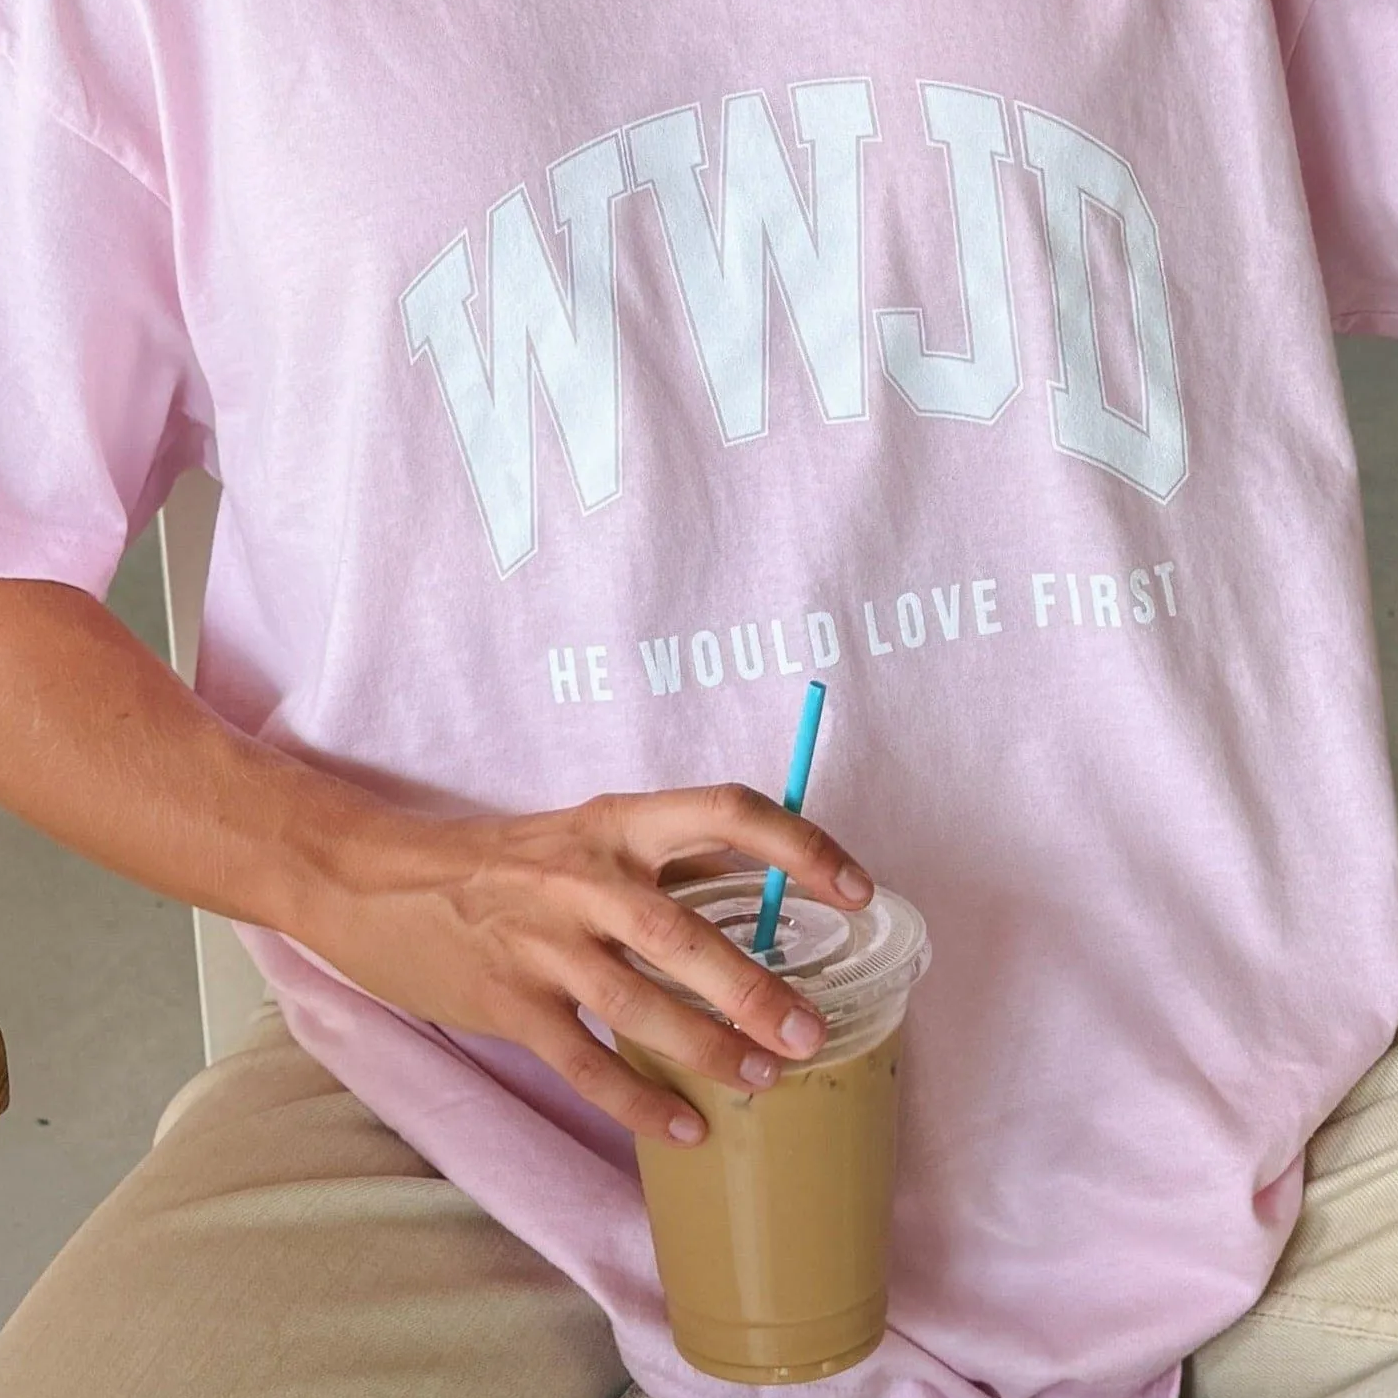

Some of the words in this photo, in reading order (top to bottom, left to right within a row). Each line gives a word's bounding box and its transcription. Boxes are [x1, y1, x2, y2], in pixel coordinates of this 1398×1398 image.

[399, 76, 1191, 581] WWJD
[548, 645, 614, 704] HE
[639, 612, 841, 697] WOULD
[863, 577, 1003, 657] LOVE
[1031, 561, 1180, 629] FIRST
